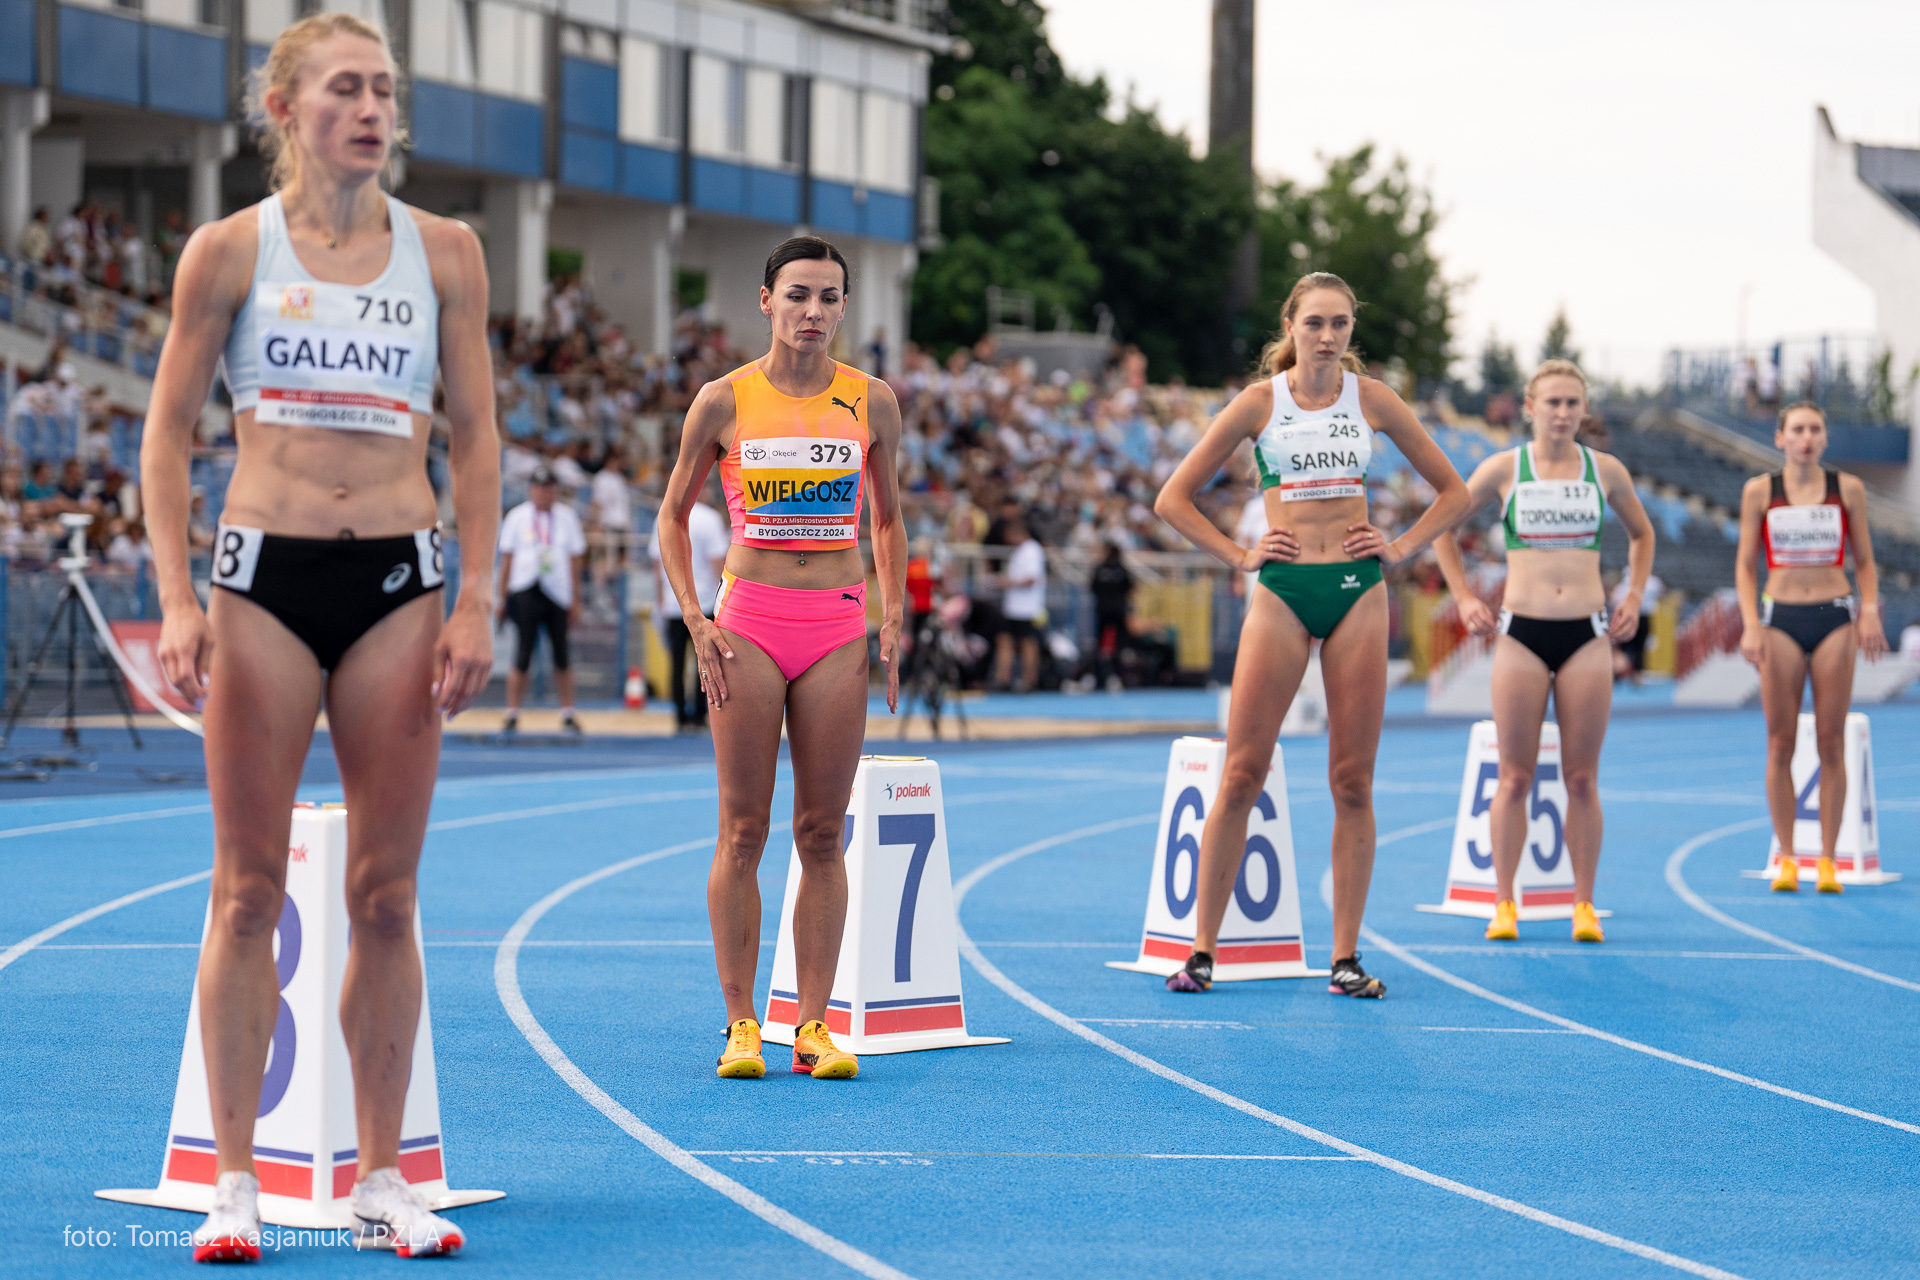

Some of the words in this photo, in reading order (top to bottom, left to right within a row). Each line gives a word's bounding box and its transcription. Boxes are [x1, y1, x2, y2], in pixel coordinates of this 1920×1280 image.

[356, 295, 413, 326] 710
[266, 337, 410, 378] GALANT
[1329, 423, 1360, 438] 245
[772, 450, 797, 458] Okęcie
[810, 444, 852, 463] 379
[1291, 450, 1359, 471] SARNA
[747, 480, 855, 503] WIELGOSZ
[1563, 485, 1591, 498] 117
[758, 528, 820, 537] BYDGOSZCZ
[823, 528, 845, 537] 2024
[760, 517, 771, 525] 100.
[829, 516, 844, 524] Polski
[219, 531, 243, 577] 8
[896, 782, 931, 801] polanik
[1467, 762, 1500, 870] 5
[1530, 764, 1565, 872] 5
[1165, 786, 1204, 920] 6
[1233, 789, 1281, 922] 6
[878, 813, 936, 983] 7
